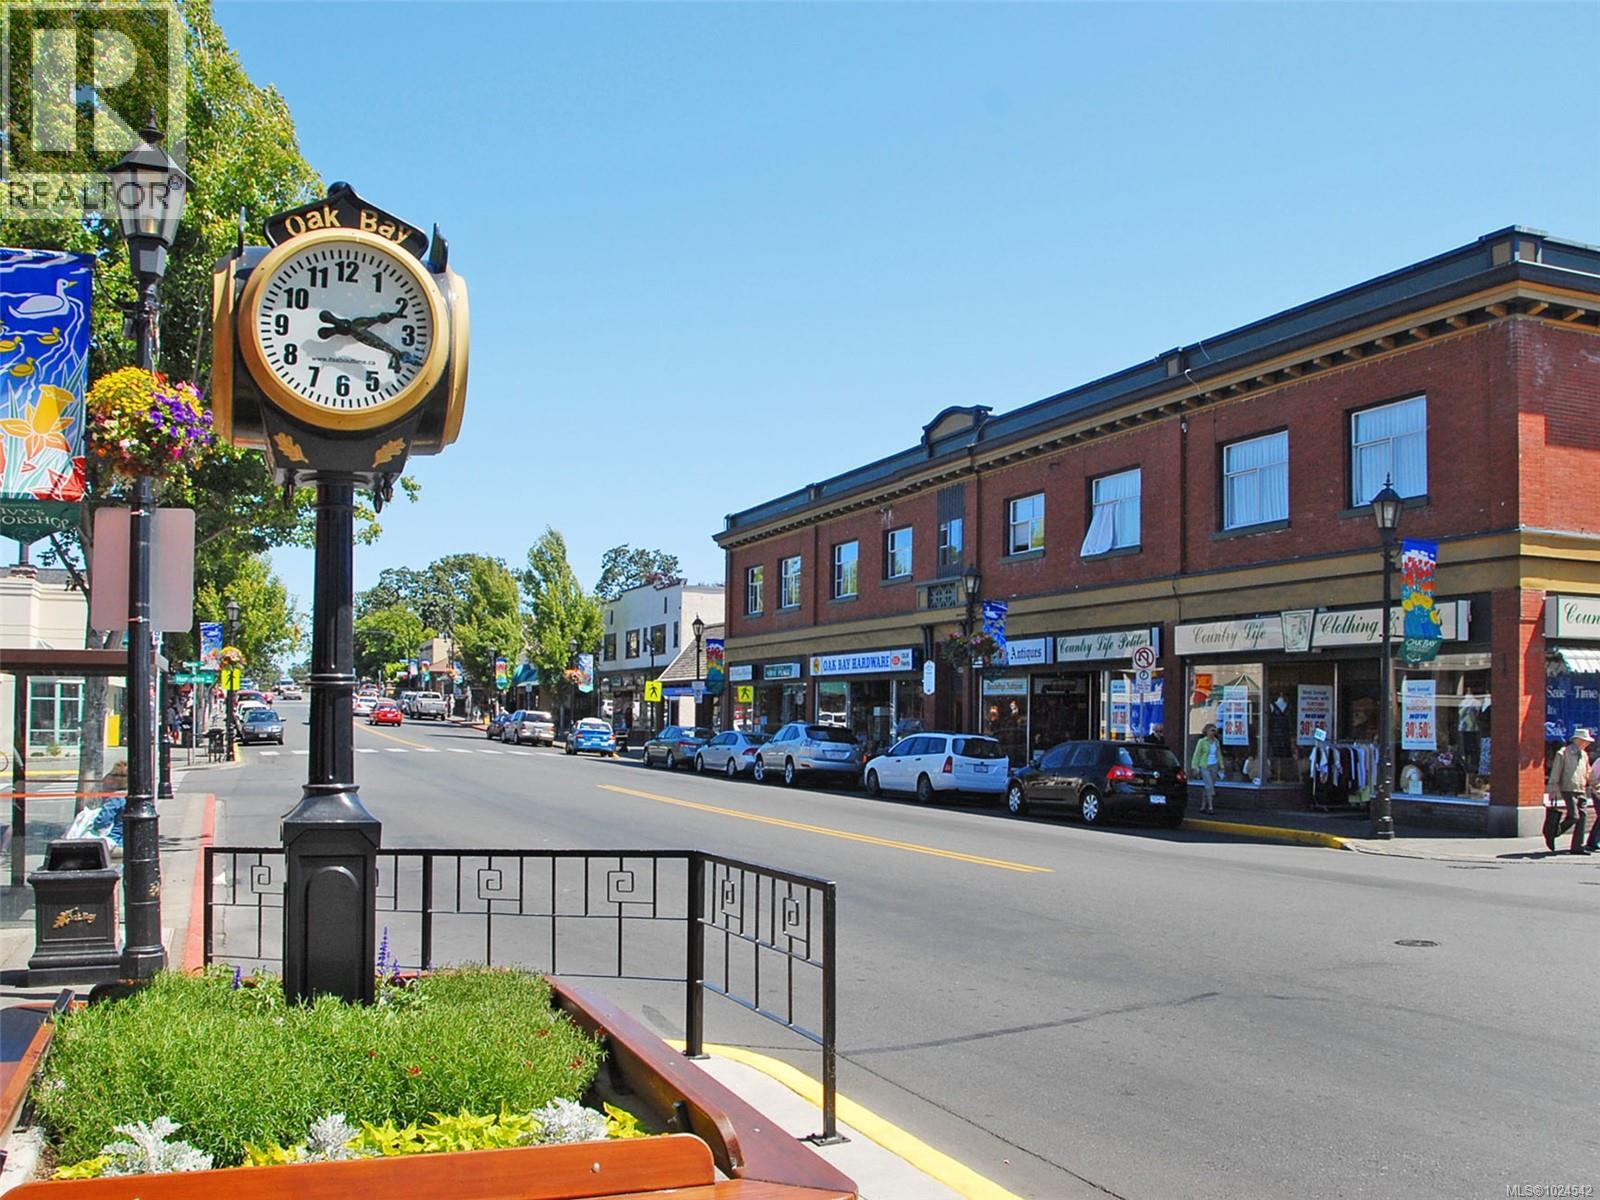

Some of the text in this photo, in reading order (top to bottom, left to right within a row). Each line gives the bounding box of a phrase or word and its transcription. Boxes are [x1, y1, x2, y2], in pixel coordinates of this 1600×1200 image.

[284, 205, 412, 244] Oak Bay
[307, 266, 328, 288] 11
[335, 261, 359, 283] 12
[372, 272, 384, 293] 1
[284, 288, 309, 310] 10
[395, 297, 409, 319] 2
[275, 314, 289, 336] 9
[401, 325, 416, 347] 3
[283, 343, 297, 365] 8
[387, 352, 402, 374] 4
[308, 366, 320, 387] 7
[336, 375, 350, 396] 6
[365, 370, 380, 392] 5
[1193, 621, 1266, 649] Country Life
[1320, 613, 1380, 641] Clothing
[1010, 646, 1042, 661] Antiques
[1057, 637, 1092, 658] Country
[1097, 634, 1113, 658] Life
[823, 658, 836, 671] OAK
[838, 657, 851, 671] BAY
[852, 655, 890, 670] HARDWARE
[1546, 684, 1598, 699] Sale Time
[1546, 722, 1598, 737] Sale Te
